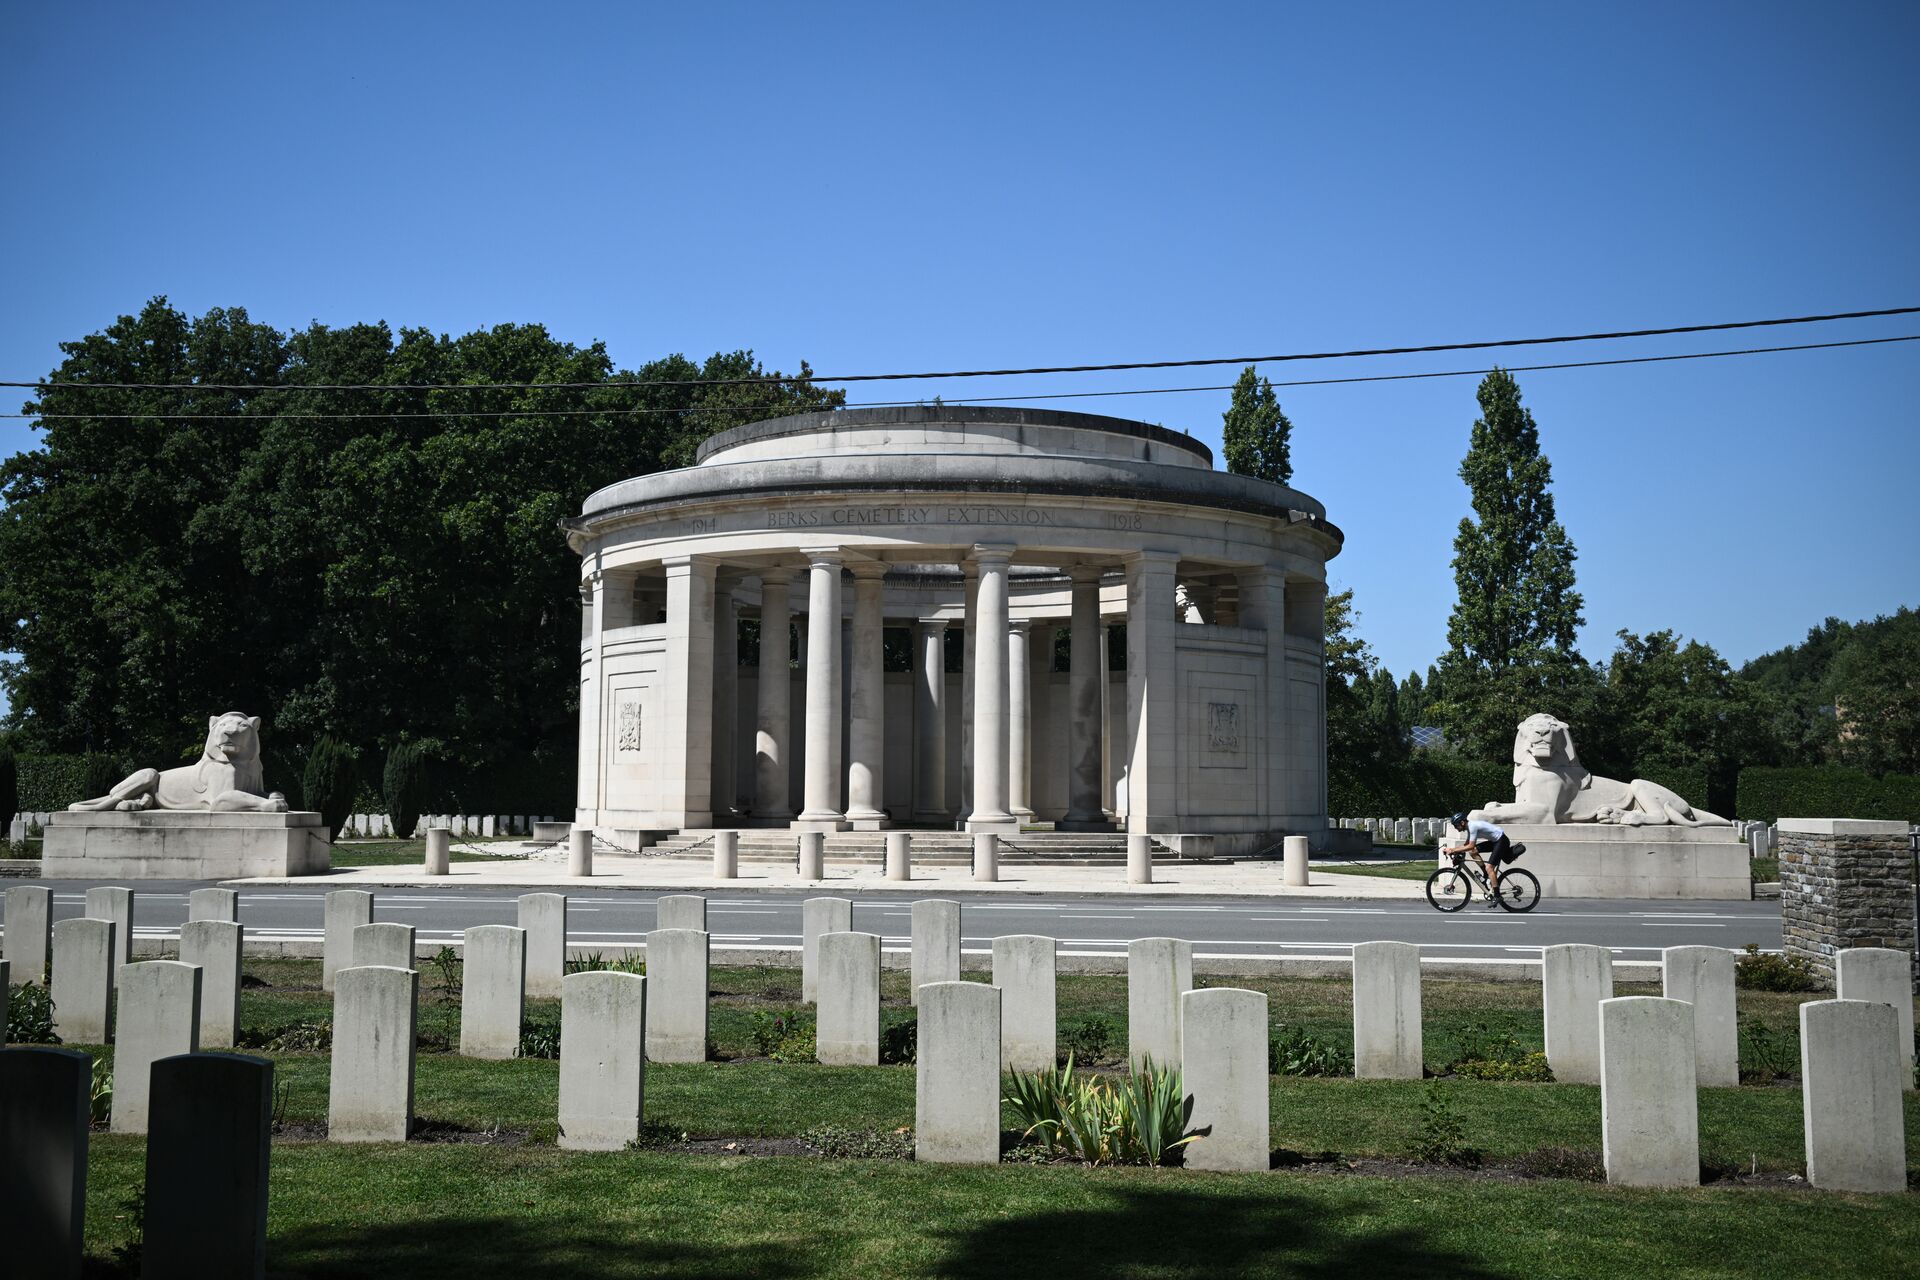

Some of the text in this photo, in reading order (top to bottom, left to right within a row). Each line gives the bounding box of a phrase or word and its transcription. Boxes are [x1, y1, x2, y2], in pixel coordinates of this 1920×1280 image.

[767, 510, 818, 527] BERKS
[832, 508, 931, 524] CEMETERY
[946, 507, 1054, 524] EXTENSION
[1113, 514, 1143, 530] 1918
